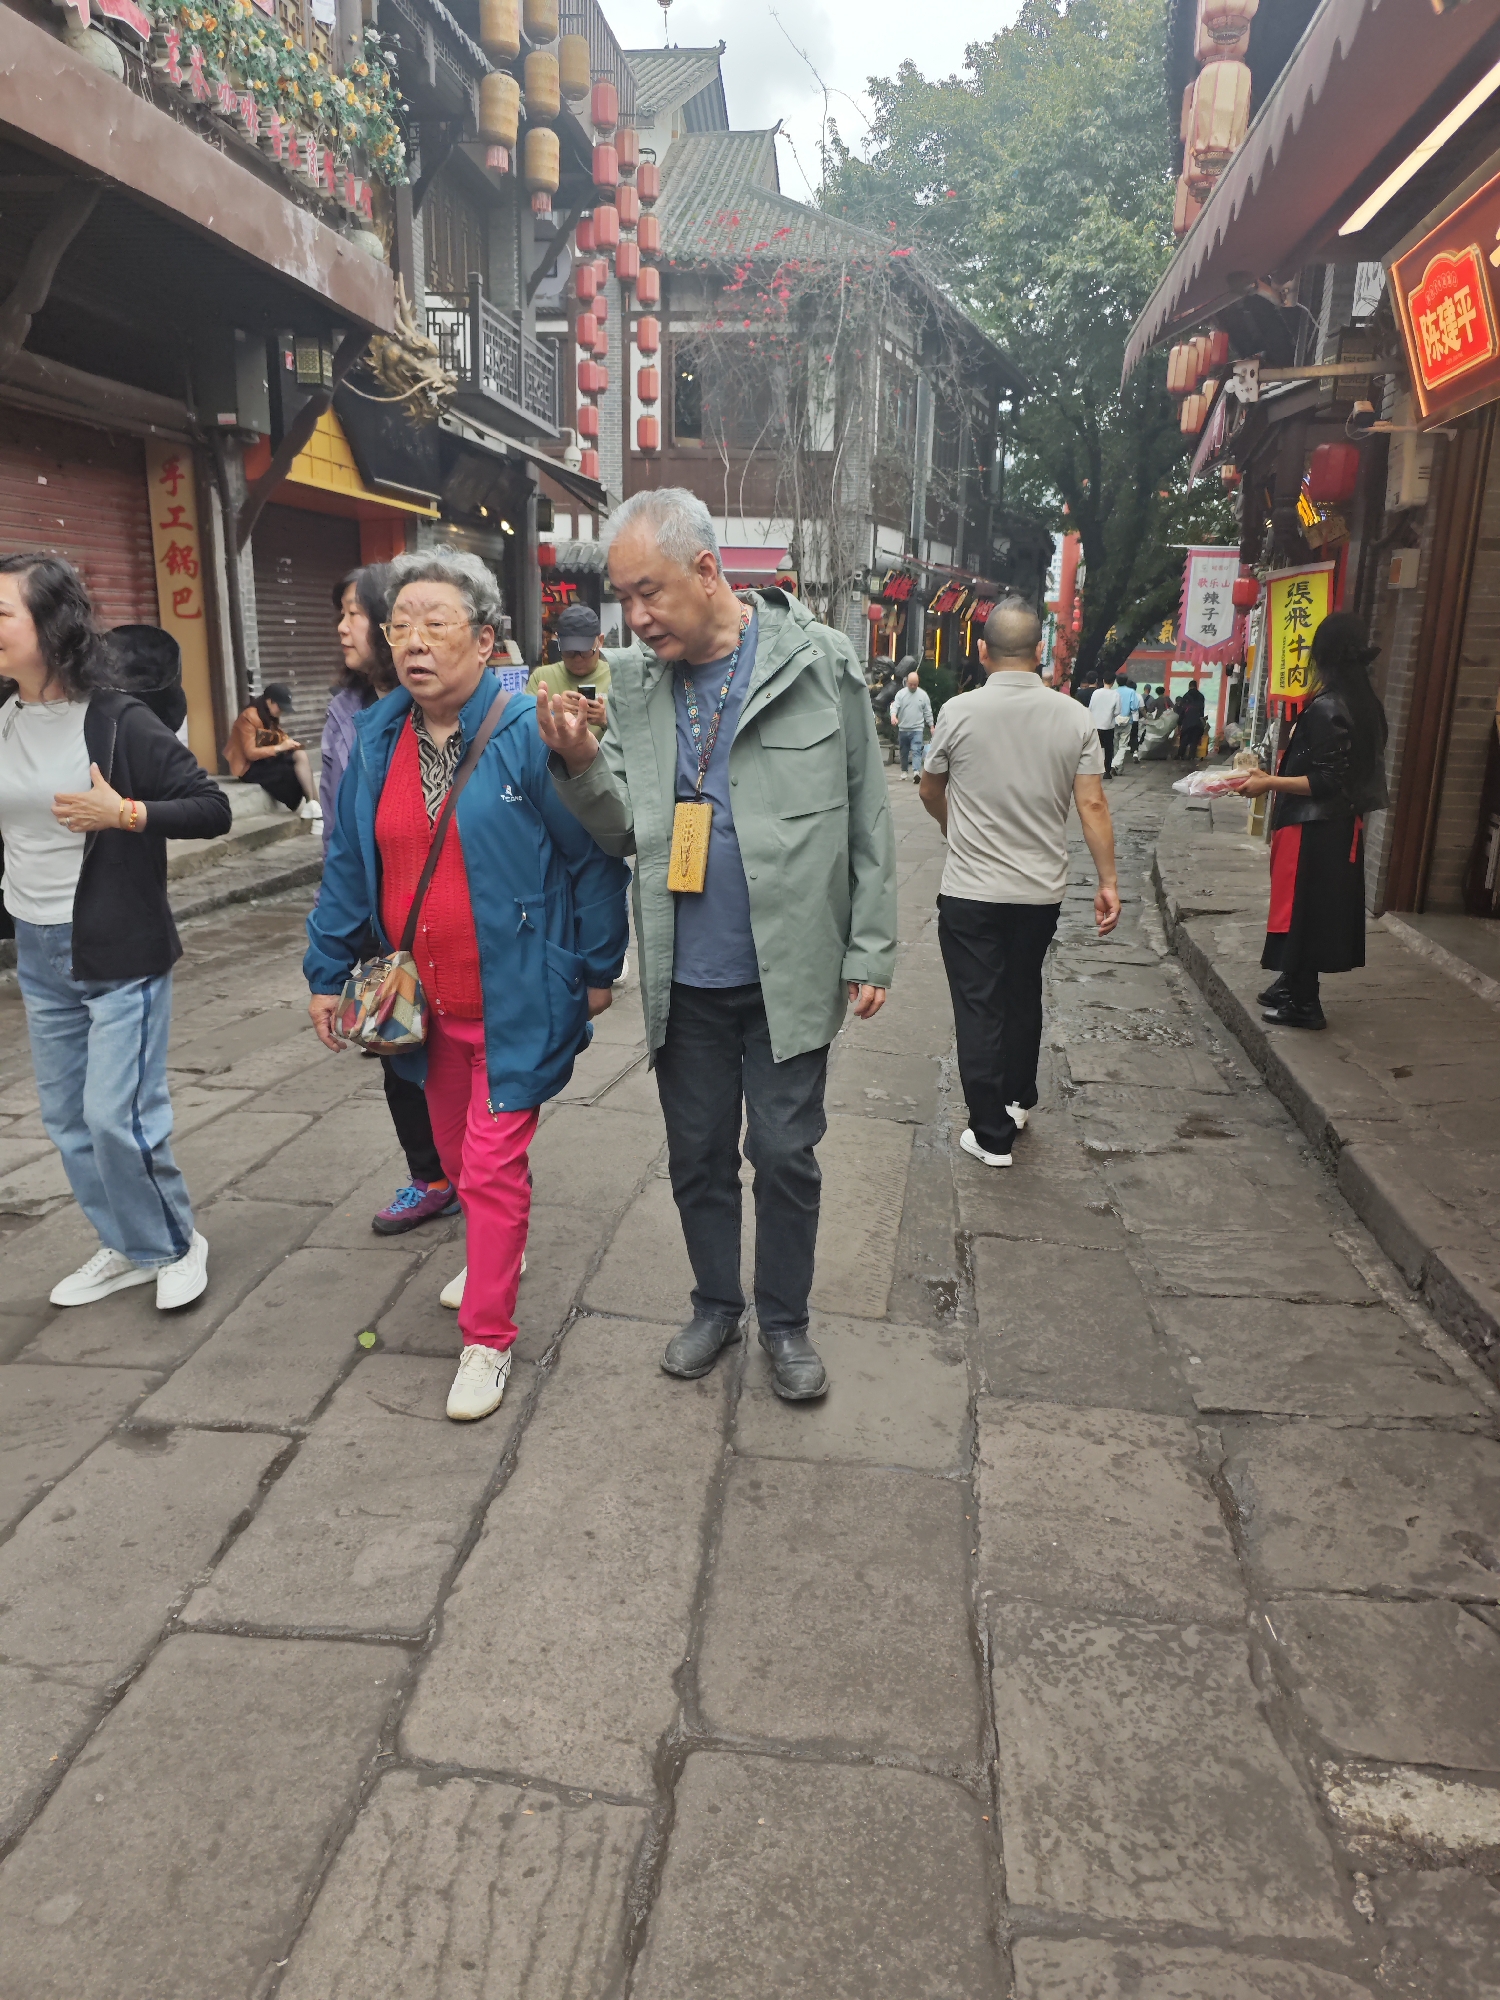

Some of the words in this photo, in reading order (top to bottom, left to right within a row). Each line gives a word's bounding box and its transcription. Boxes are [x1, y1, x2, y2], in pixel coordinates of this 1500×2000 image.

[1419, 285, 1476, 367] 陈建平
[1197, 577, 1230, 588] 歌乐山
[1200, 591, 1221, 637] 辣子鸡
[1284, 581, 1313, 688] 張飛牛肉
